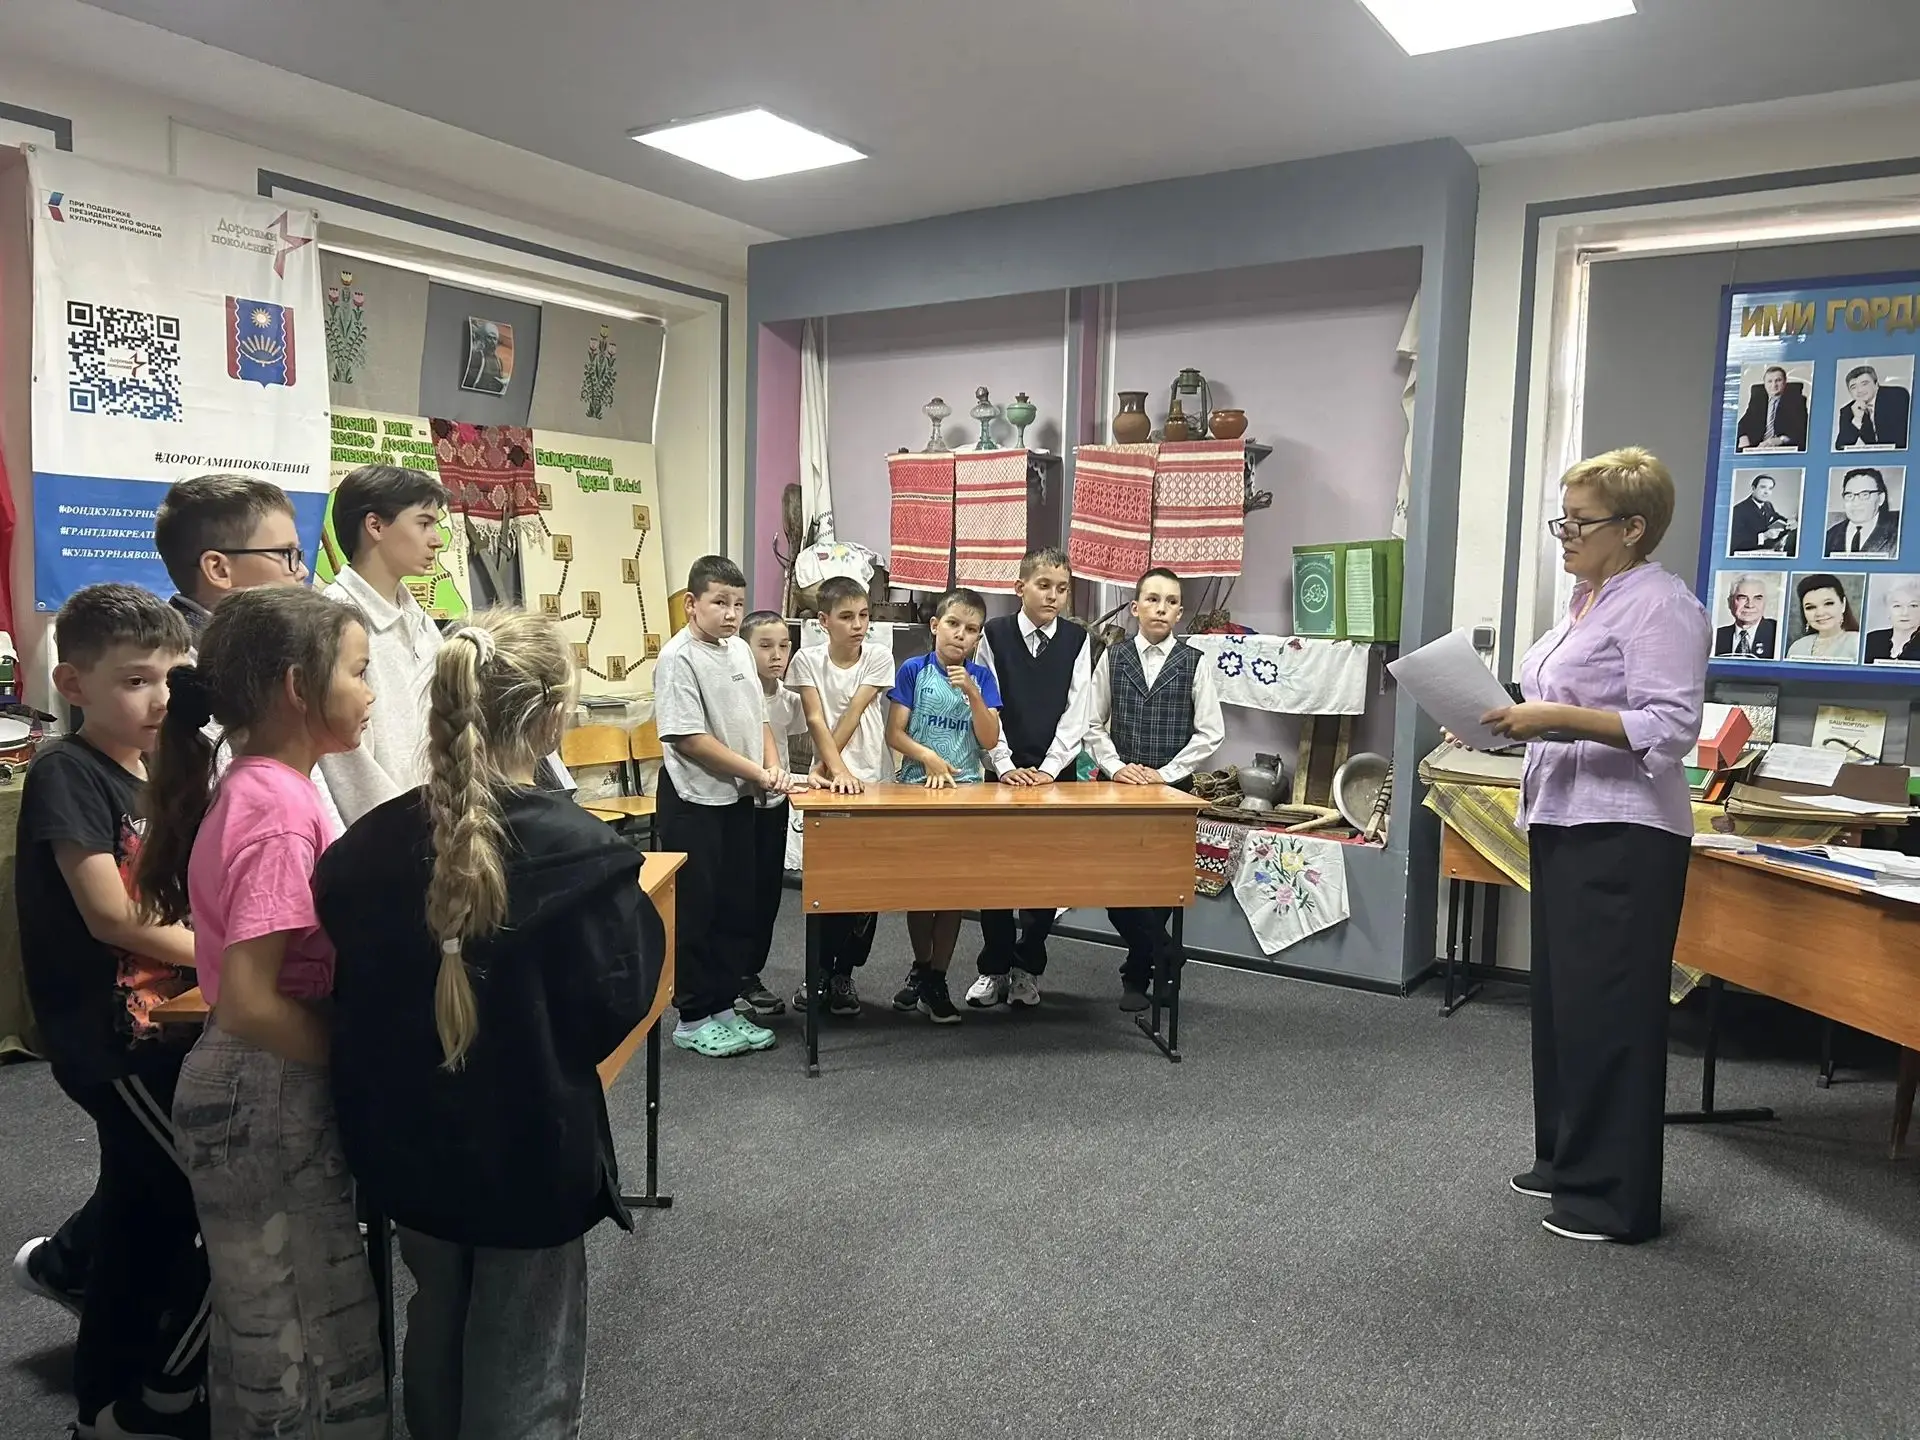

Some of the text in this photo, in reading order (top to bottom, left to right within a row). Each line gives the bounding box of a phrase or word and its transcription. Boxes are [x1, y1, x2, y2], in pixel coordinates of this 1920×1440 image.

[69, 199, 131, 219] ПРИ ПОДДЕРЖКЕ
[69, 206, 162, 232] ПРЕЗИДЕНТСКОГО ФОНДА
[69, 214, 162, 239] КУЛЬТУРНЫХ ИНИЦИАТИВ
[1742, 294, 1920, 337] ИМИ ГОРД
[155, 452, 310, 474] #ДОРОГАМИПОКОЛЕНИЙ
